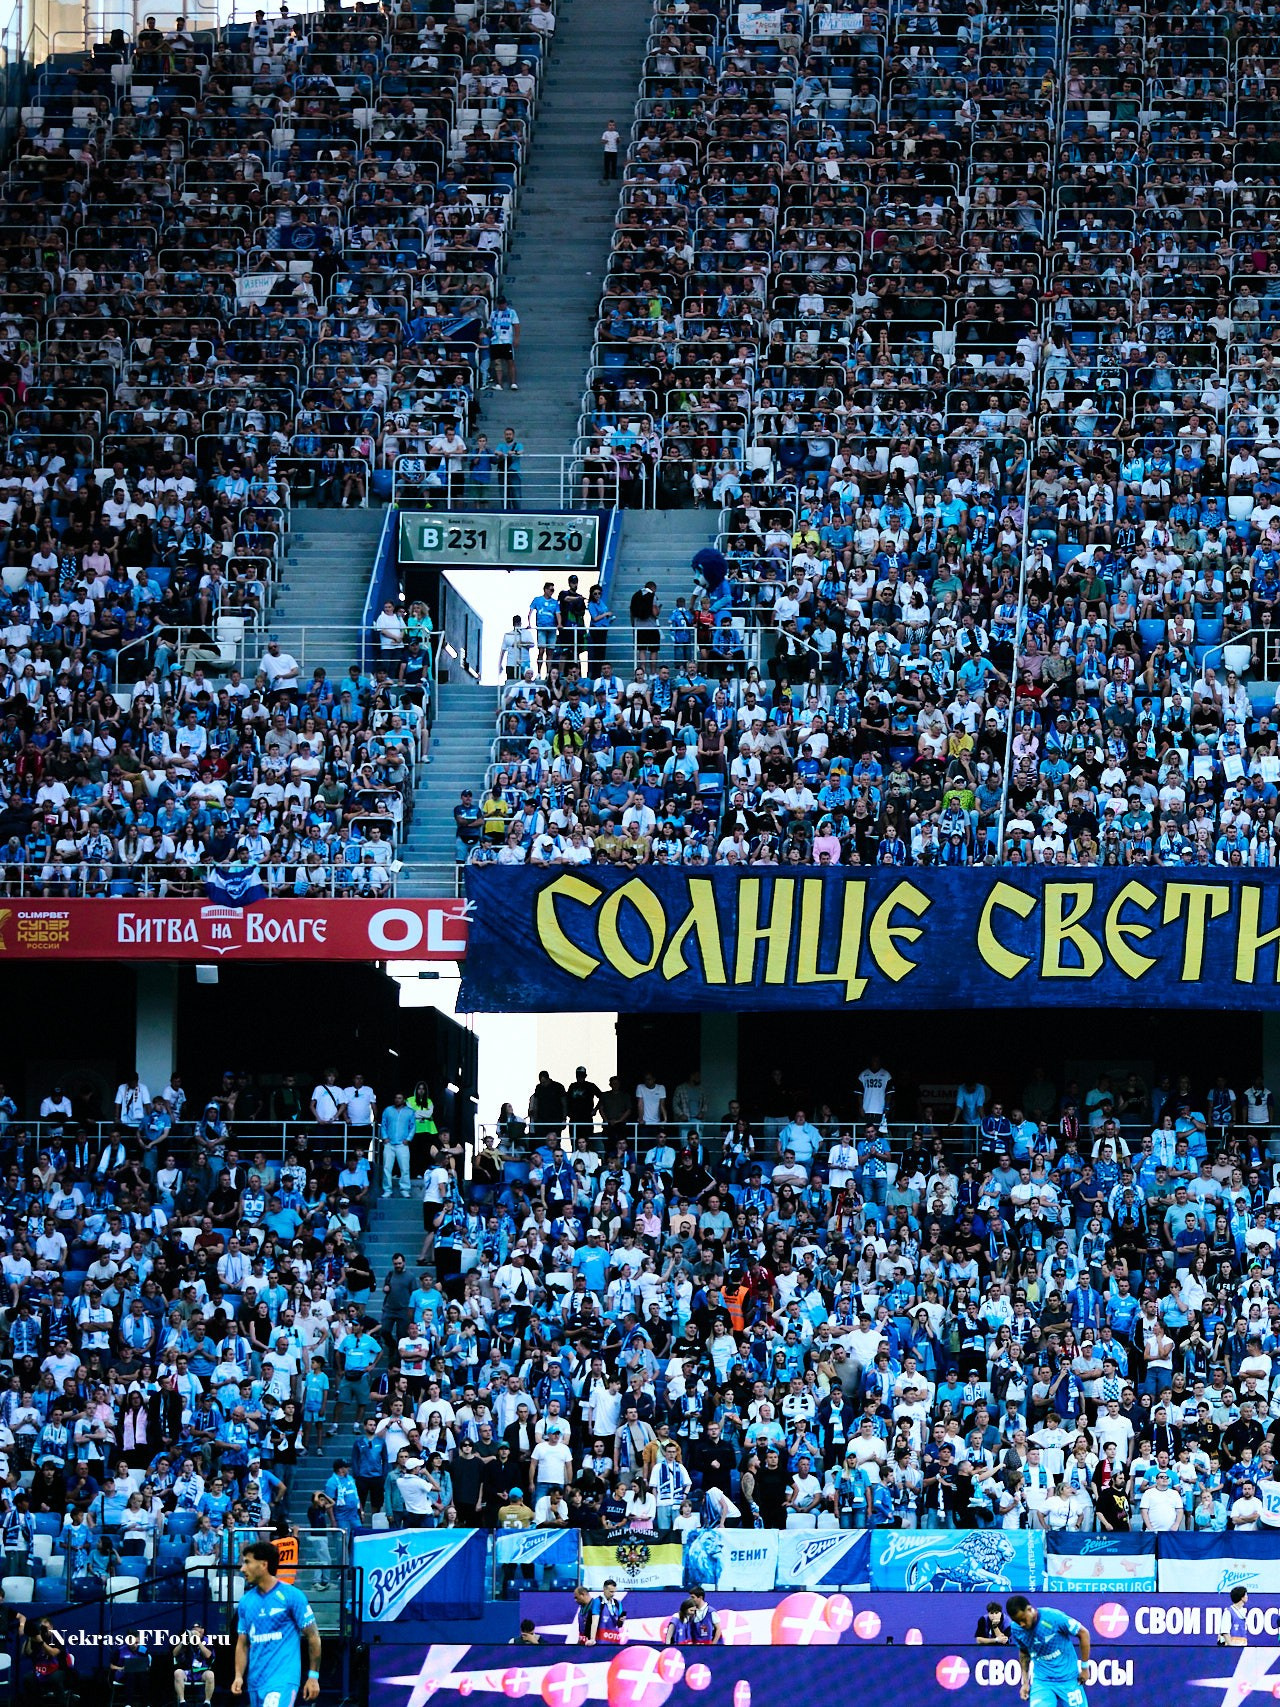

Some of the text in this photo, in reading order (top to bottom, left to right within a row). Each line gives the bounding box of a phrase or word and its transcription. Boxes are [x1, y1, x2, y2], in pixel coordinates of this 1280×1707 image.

[423, 528, 487, 550] B 231
[513, 530, 583, 551] B 230
[17, 911, 70, 919] OLIMPBET
[17, 920, 70, 931] СУПЕР
[17, 931, 70, 942] КУБОК
[536, 873, 932, 1002] СОЛНЦЕ
[1267, 1494, 1280, 1514] 12
[730, 1548, 768, 1561] ЗЕНИТ
[880, 1533, 940, 1566] Зенит
[369, 1545, 443, 1618] Зенит
[1135, 1607, 1201, 1635] СВОИ
[1067, 1688, 1084, 1707] 20
